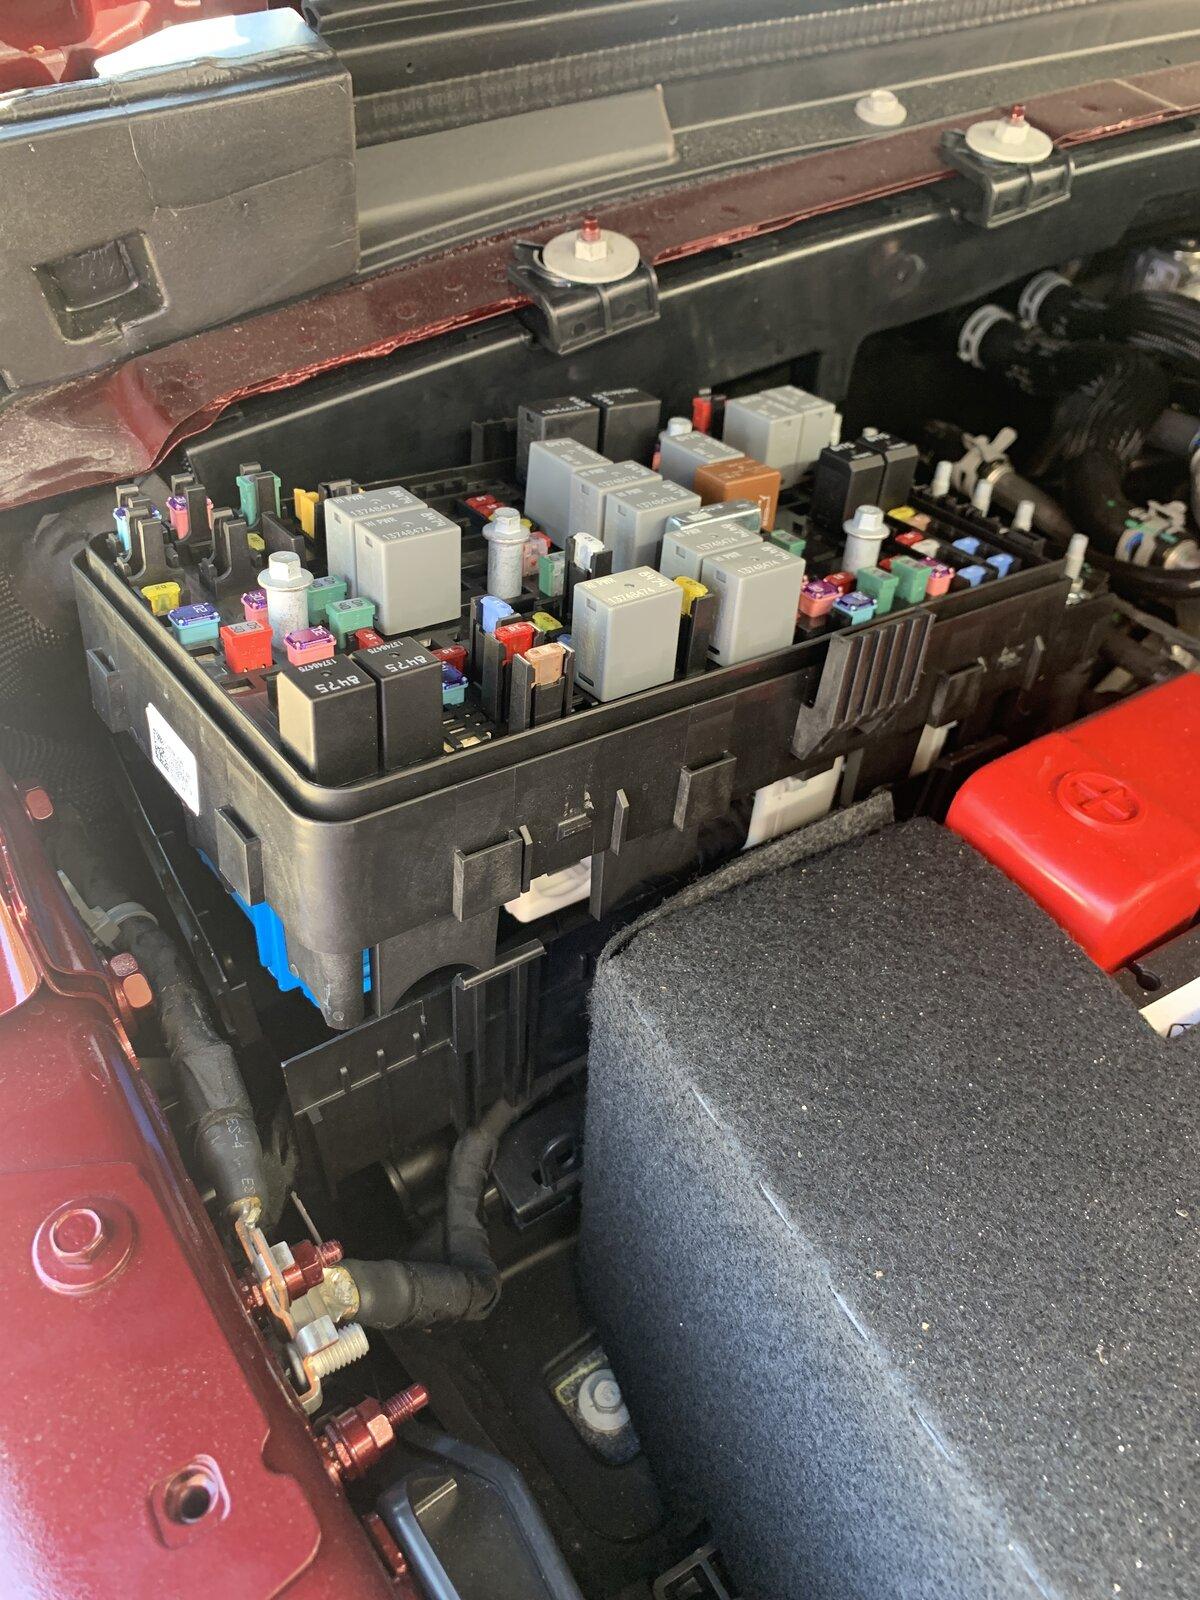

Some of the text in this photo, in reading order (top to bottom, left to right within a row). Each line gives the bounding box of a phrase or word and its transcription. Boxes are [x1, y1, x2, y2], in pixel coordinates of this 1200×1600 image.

[350, 502, 399, 517] 13748474
[382, 526, 431, 540] 13748474
[607, 587, 655, 604] 13748474
[367, 640, 404, 655] 13748475
[298, 658, 338, 673] 13748475
[385, 655, 428, 673] 8475
[315, 675, 361, 693] 8475
